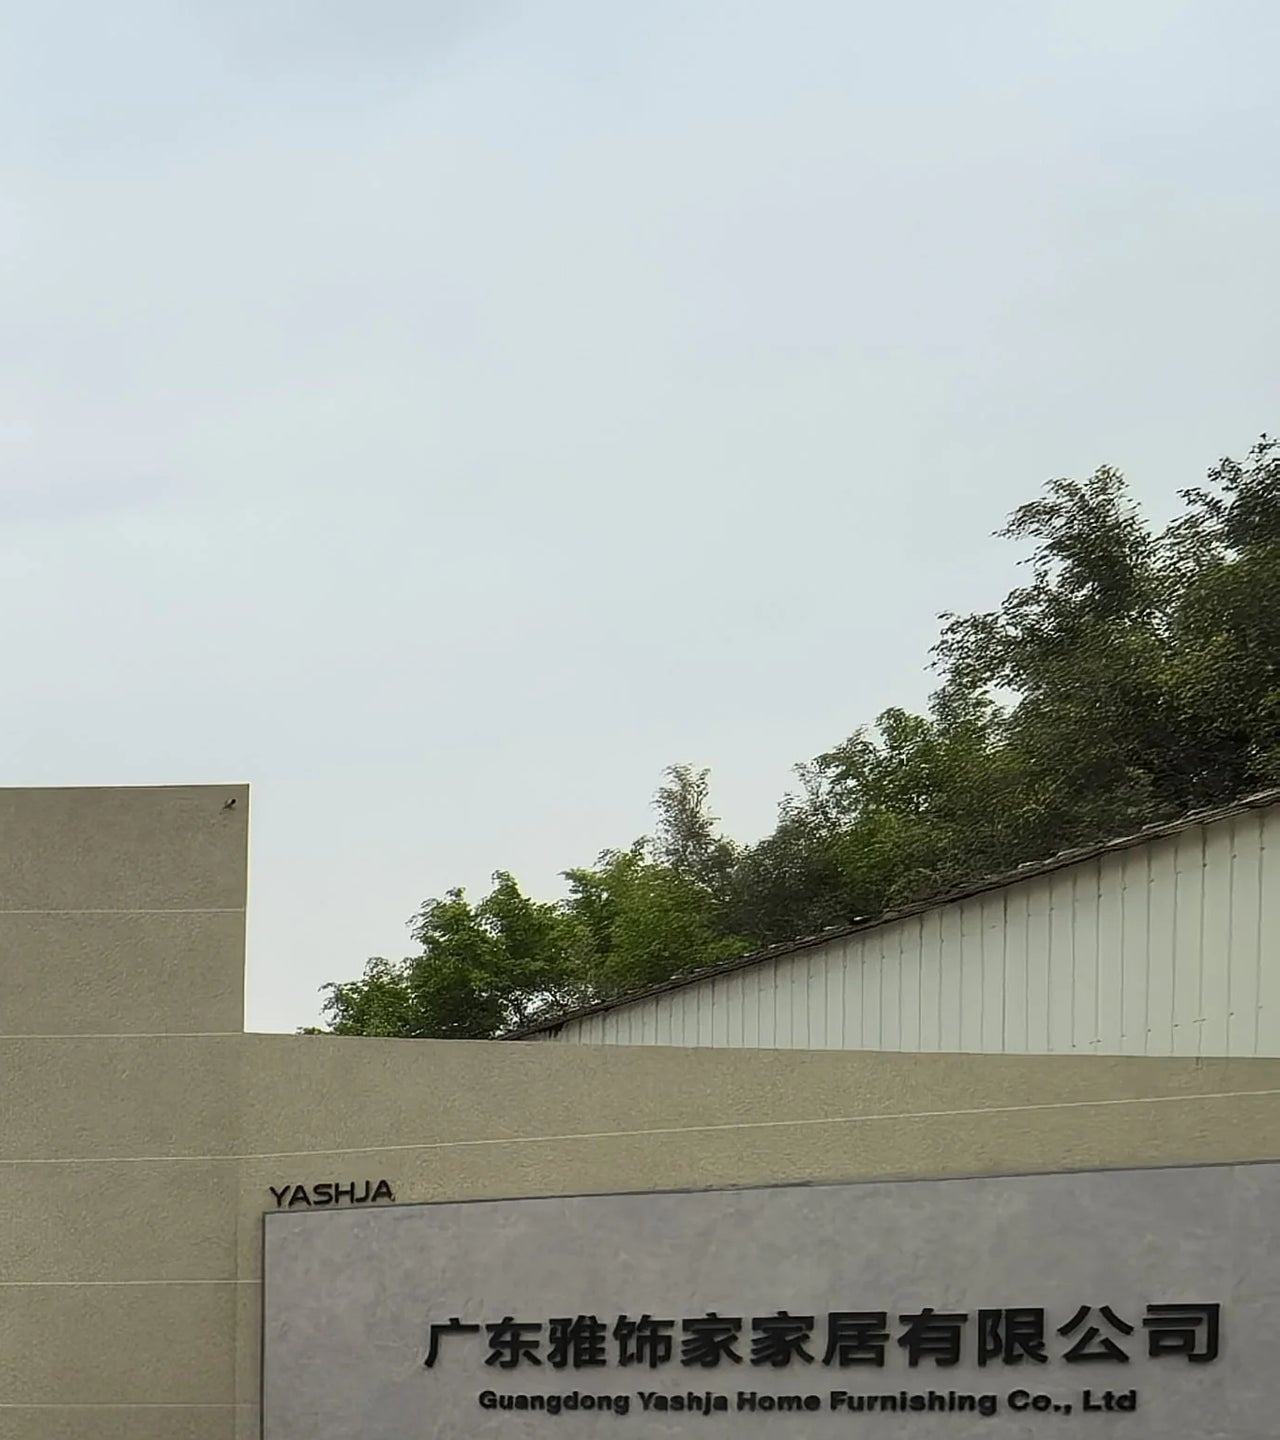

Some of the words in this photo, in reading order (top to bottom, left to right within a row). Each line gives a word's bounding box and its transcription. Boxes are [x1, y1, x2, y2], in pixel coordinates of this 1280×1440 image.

[269, 1179, 396, 1208] YASHJA
[424, 1303, 1222, 1369] 广东雅饰家家居有限公司
[478, 1390, 630, 1415] Guangdong
[637, 1390, 728, 1415] Yashja
[736, 1390, 821, 1412] Home
[829, 1390, 997, 1416] Furnishing
[1007, 1389, 1072, 1415] Co.,
[1082, 1389, 1137, 1411] Ltd
